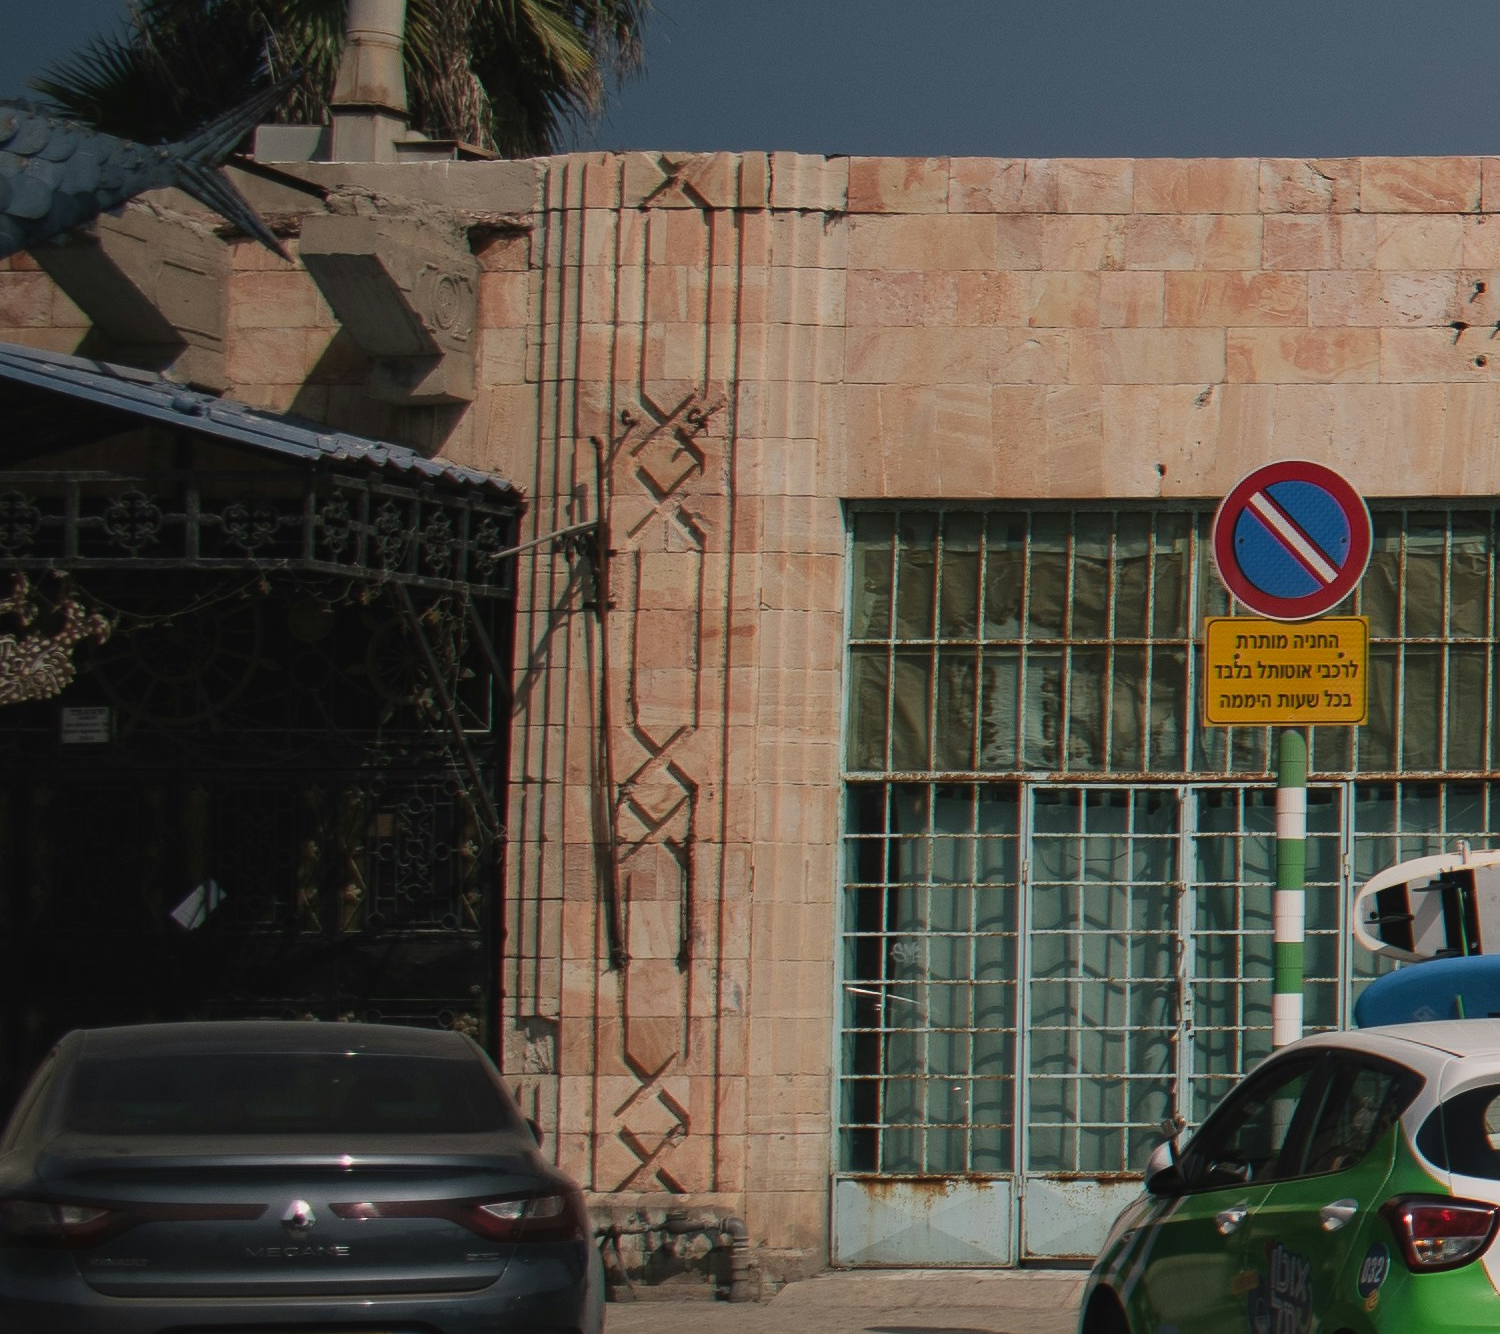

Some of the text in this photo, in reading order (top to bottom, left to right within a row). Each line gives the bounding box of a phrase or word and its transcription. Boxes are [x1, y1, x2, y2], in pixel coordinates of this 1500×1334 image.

[1235, 634, 1339, 650] החניה מותרת
[1214, 660, 1359, 679] לרכבי אוטותל בלבד
[1219, 690, 1353, 709] בכל שעות היממה
[244, 1245, 351, 1258] MEGANE
[1361, 1255, 1385, 1283] 032
